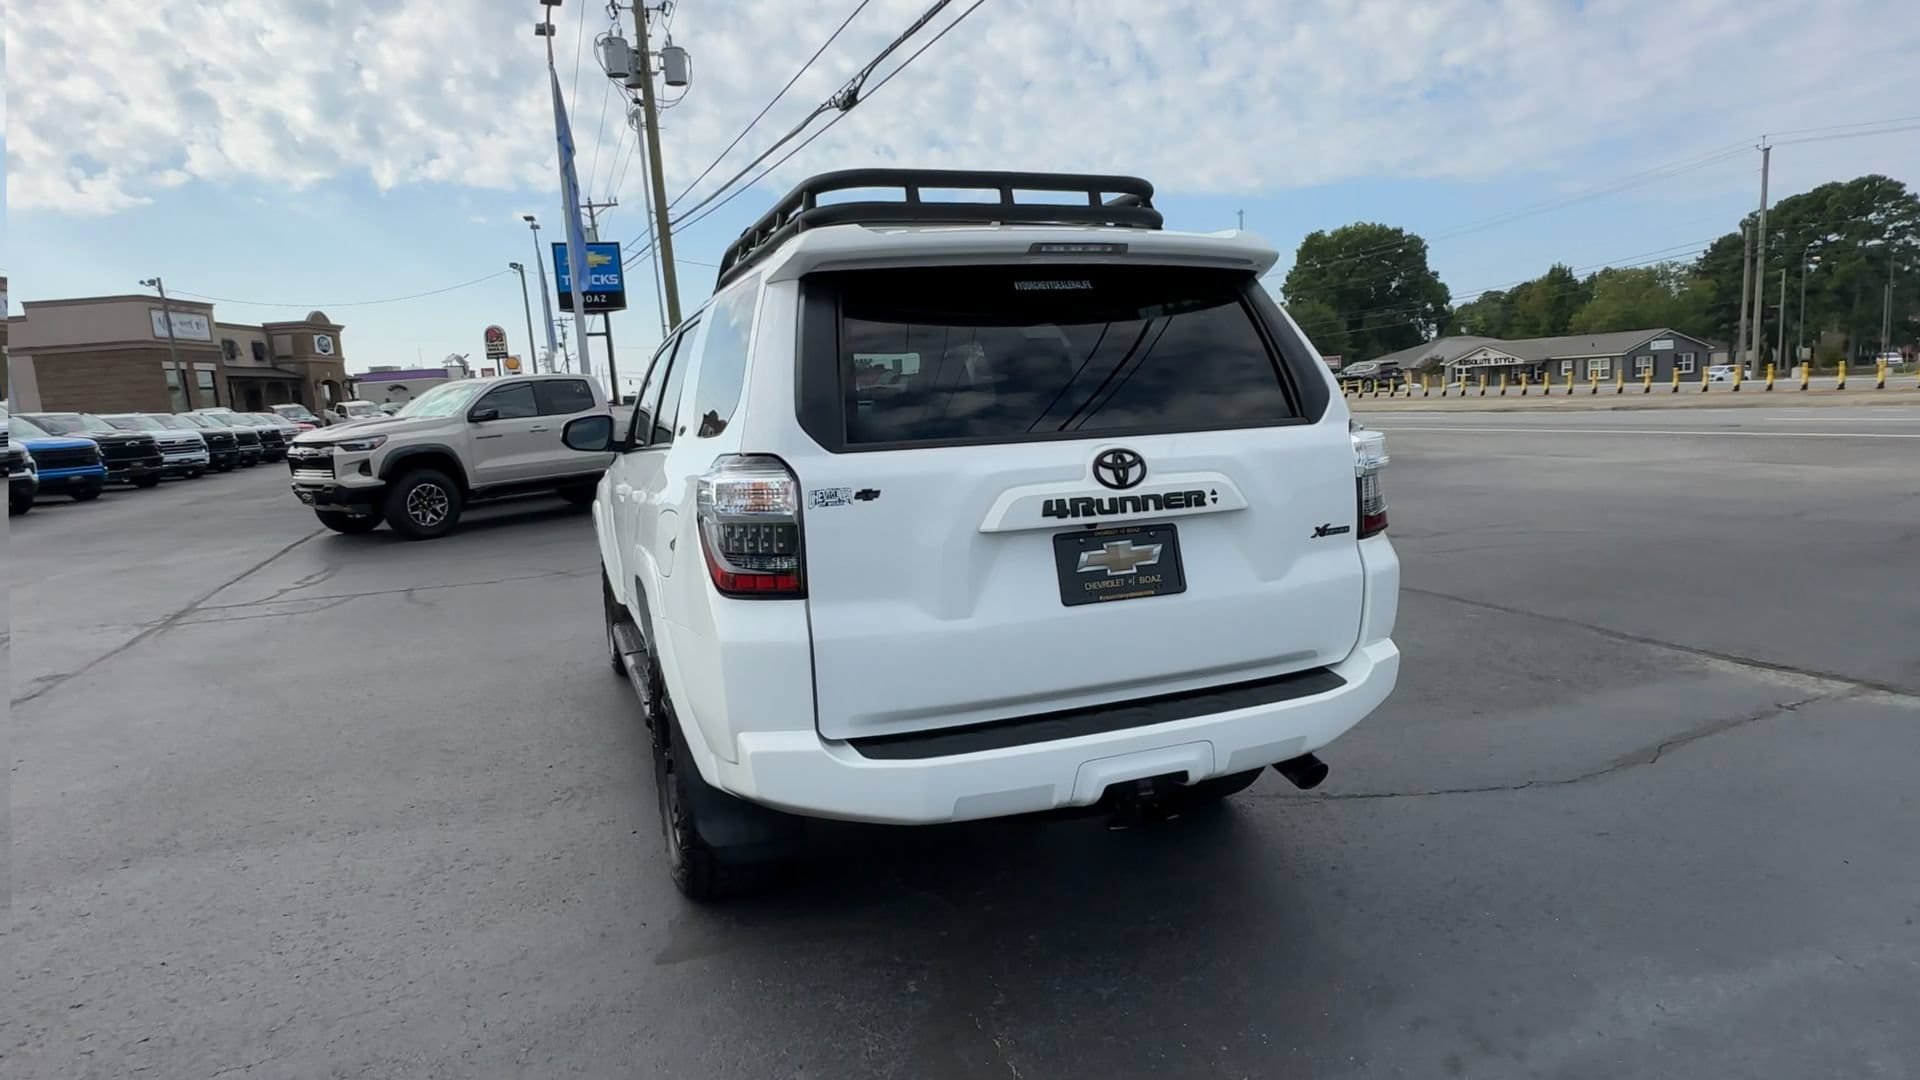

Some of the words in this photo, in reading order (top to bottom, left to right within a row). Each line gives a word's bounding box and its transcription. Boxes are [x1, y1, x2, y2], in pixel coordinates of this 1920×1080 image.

[561, 274, 618, 285] TCKS
[581, 295, 607, 303] OAZ
[1042, 489, 1207, 519] 4RUNNER
[1084, 578, 1125, 591] CHEVROLET
[1139, 574, 1162, 585] BOAZ
